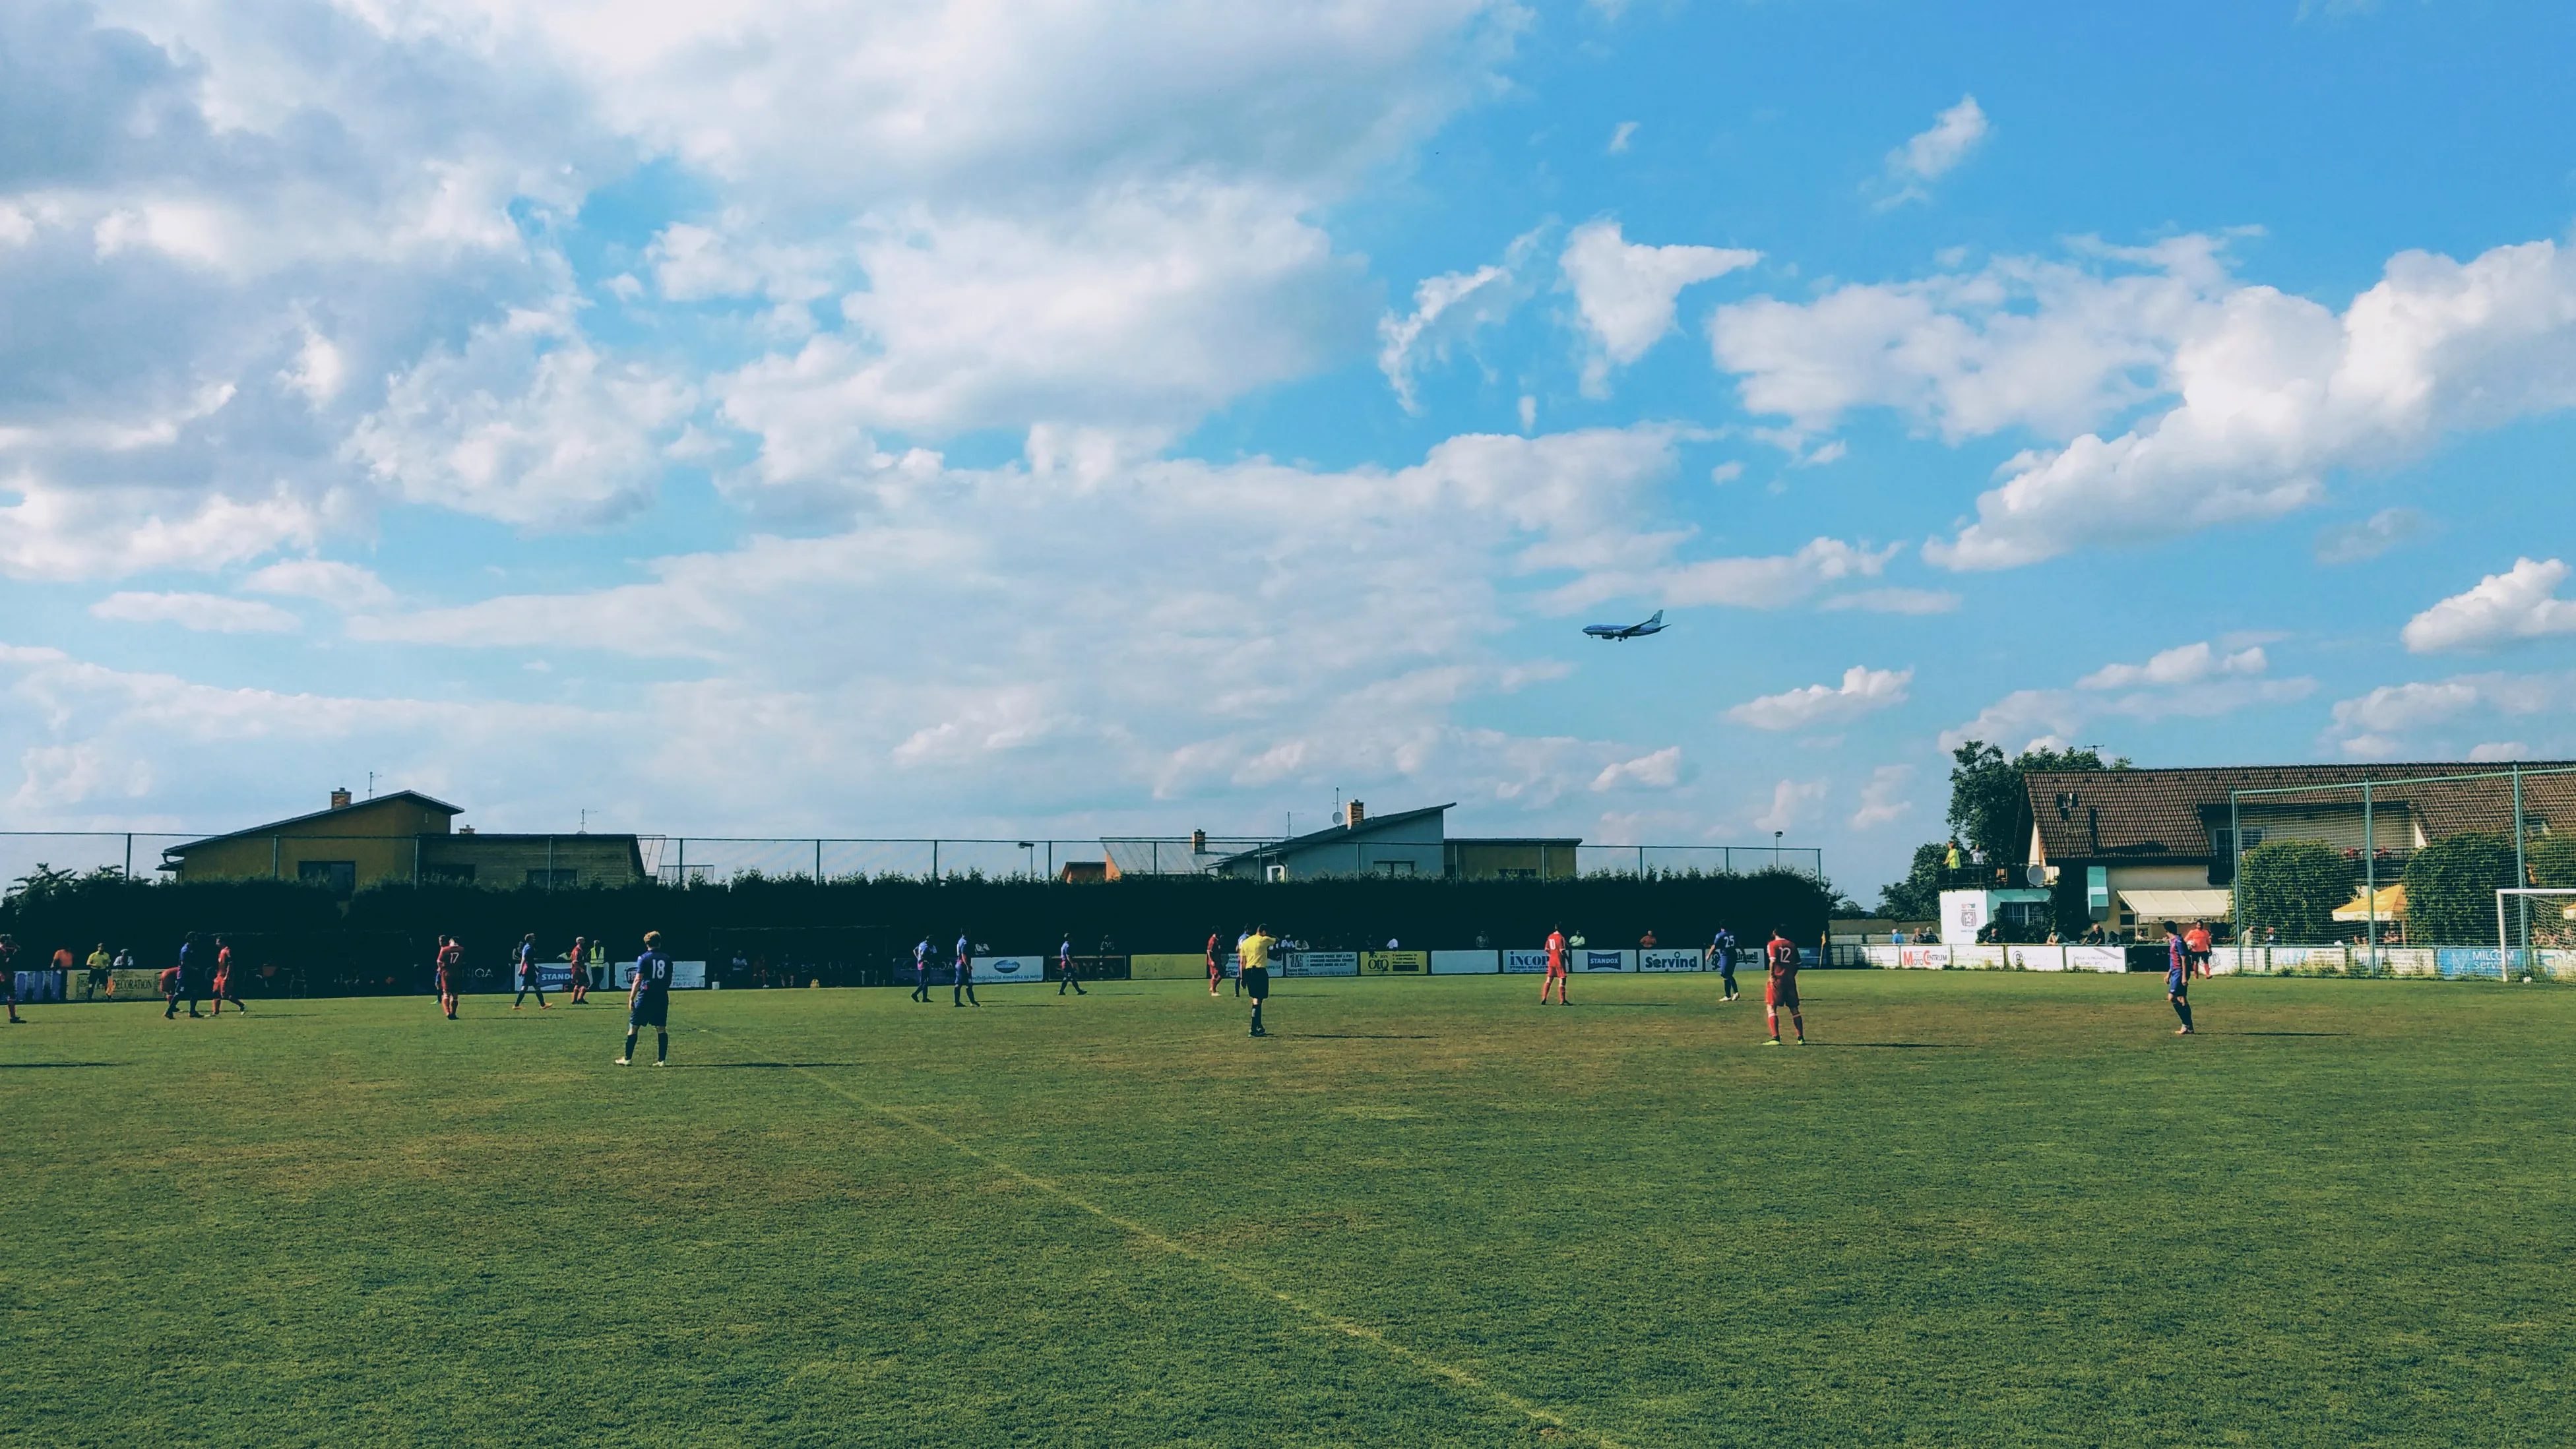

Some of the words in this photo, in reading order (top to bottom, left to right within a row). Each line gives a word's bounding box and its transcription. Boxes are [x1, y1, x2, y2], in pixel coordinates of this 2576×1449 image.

[1724, 935, 1735, 948] 25
[450, 952, 460, 964] 17
[1645, 952, 1697, 968] Servind
[1778, 946, 1791, 963] 12
[652, 958, 666, 979] 18
